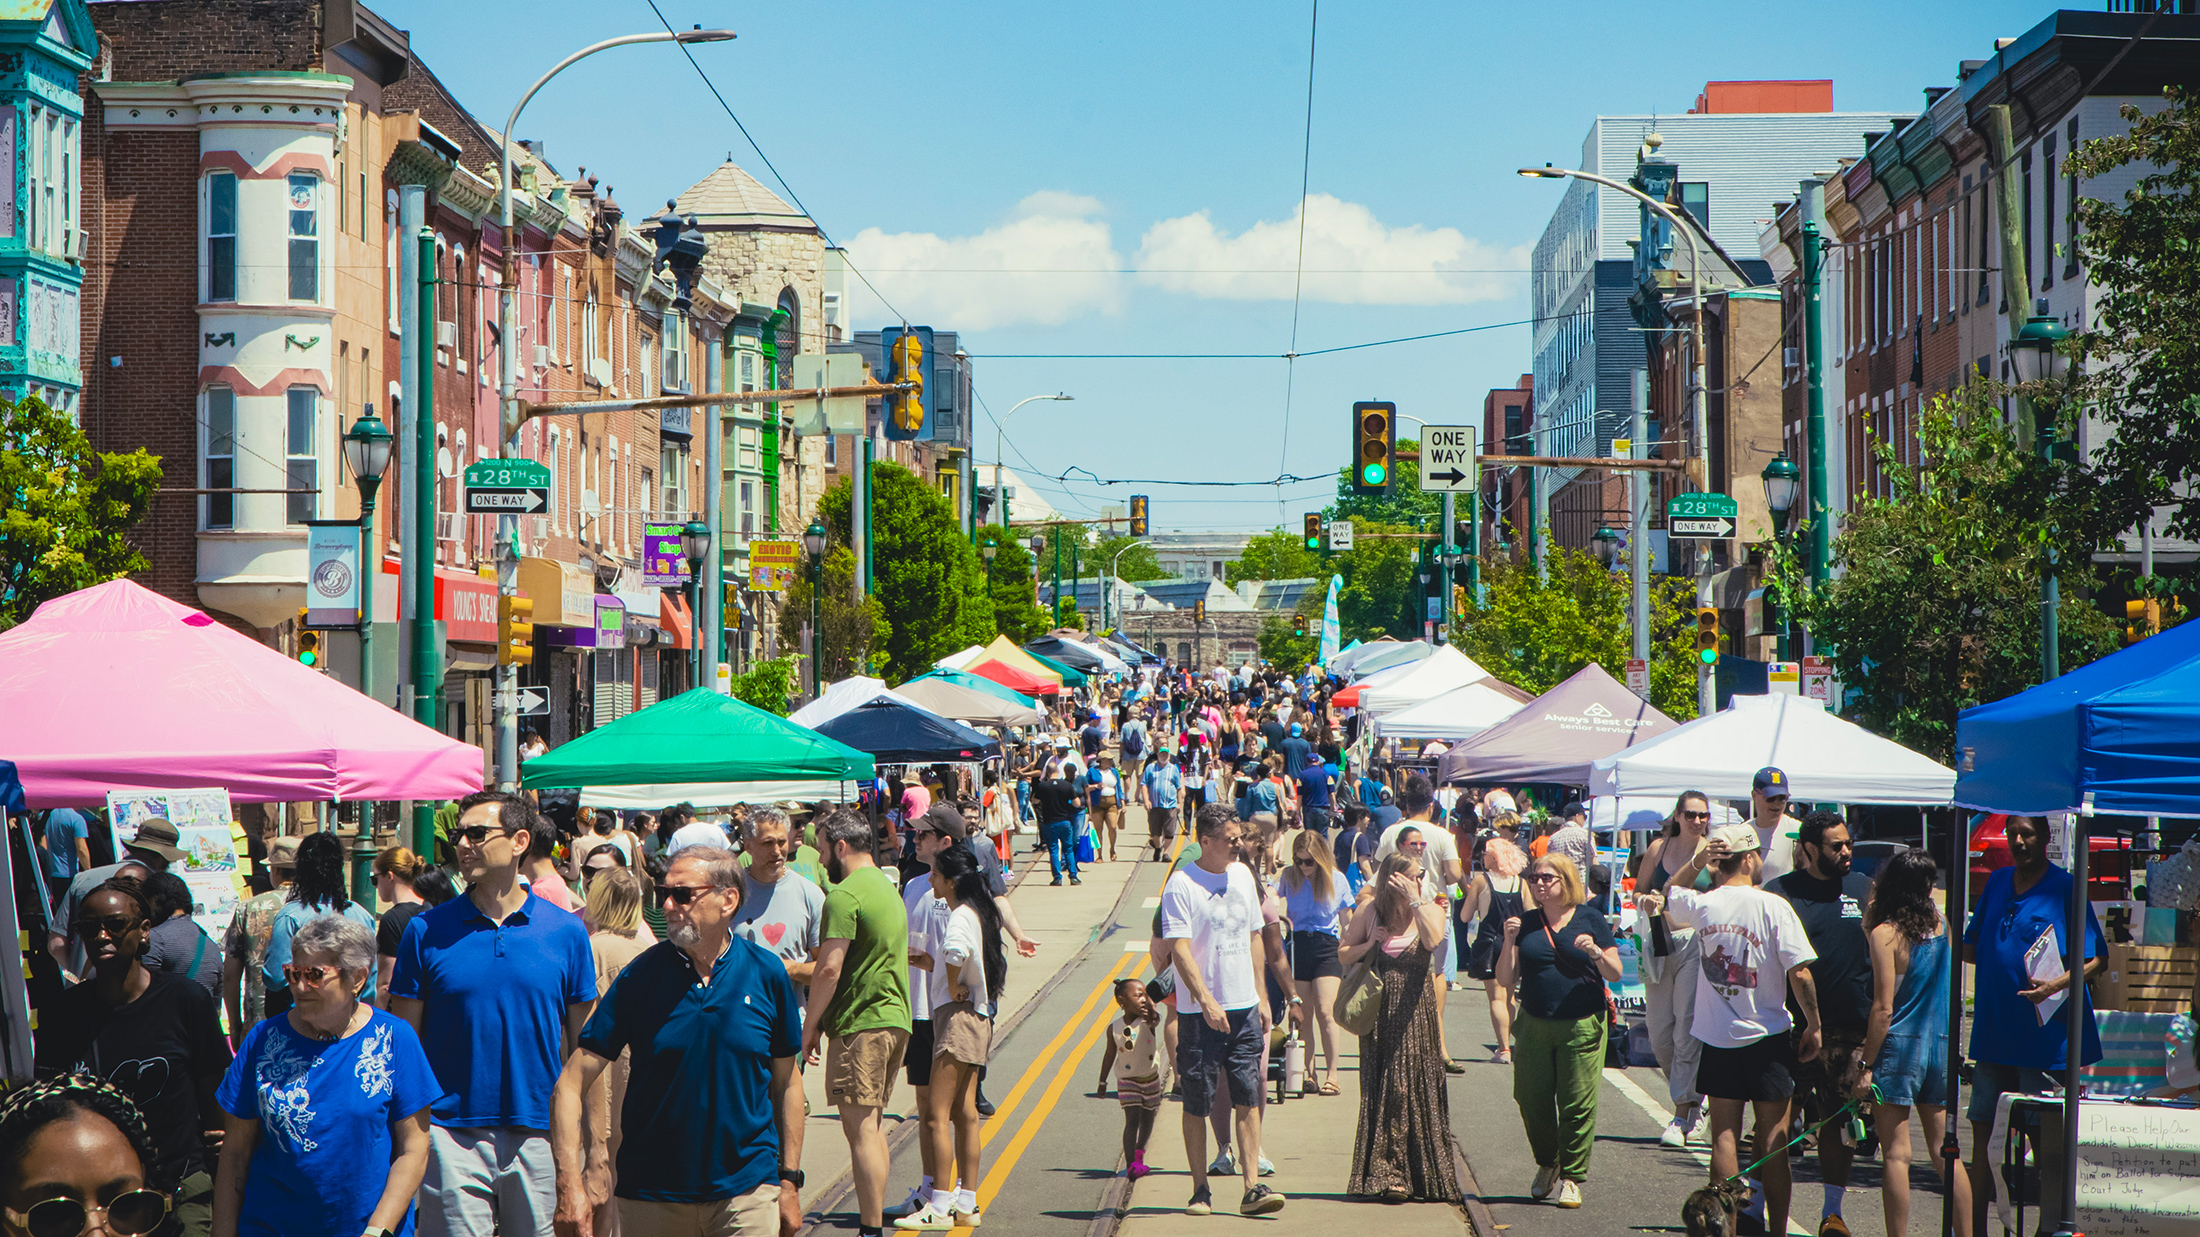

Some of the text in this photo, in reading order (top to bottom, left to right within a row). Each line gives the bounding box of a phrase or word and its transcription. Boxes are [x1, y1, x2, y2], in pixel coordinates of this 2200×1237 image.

[1432, 432, 1465, 446] ONE
[1431, 449, 1467, 463] WAY
[483, 469, 547, 485] 28TH ST
[475, 495, 525, 505] ONE WAY
[1684, 501, 1736, 514] 28TH ST
[646, 524, 672, 536] Smart
[1677, 522, 1718, 531] ONE WAY
[658, 541, 681, 556] Shop
[758, 545, 791, 555] EXOTIC
[453, 590, 476, 622] YOUNG'S
[1804, 666, 1831, 674] STOPPING
[1810, 686, 1827, 695] ZONE
[1544, 713, 1589, 725] Always
[1593, 717, 1621, 726] Best
[1560, 723, 1593, 731] senior
[2090, 1114, 2139, 1134] Please
[2144, 1115, 2169, 1141] Help
[2127, 1135, 2159, 1150] Daniel
[2083, 1152, 2197, 1173] Sign Petition to put
[2080, 1169, 2096, 1180] him
[2116, 1167, 2145, 1179] Ballot
[2149, 1167, 2162, 1178] for
[2081, 1182, 2144, 1198] Court Judge
[2110, 1202, 2123, 1214] the
[2082, 1214, 2092, 1222] of
[2134, 1226, 2150, 1235] the
